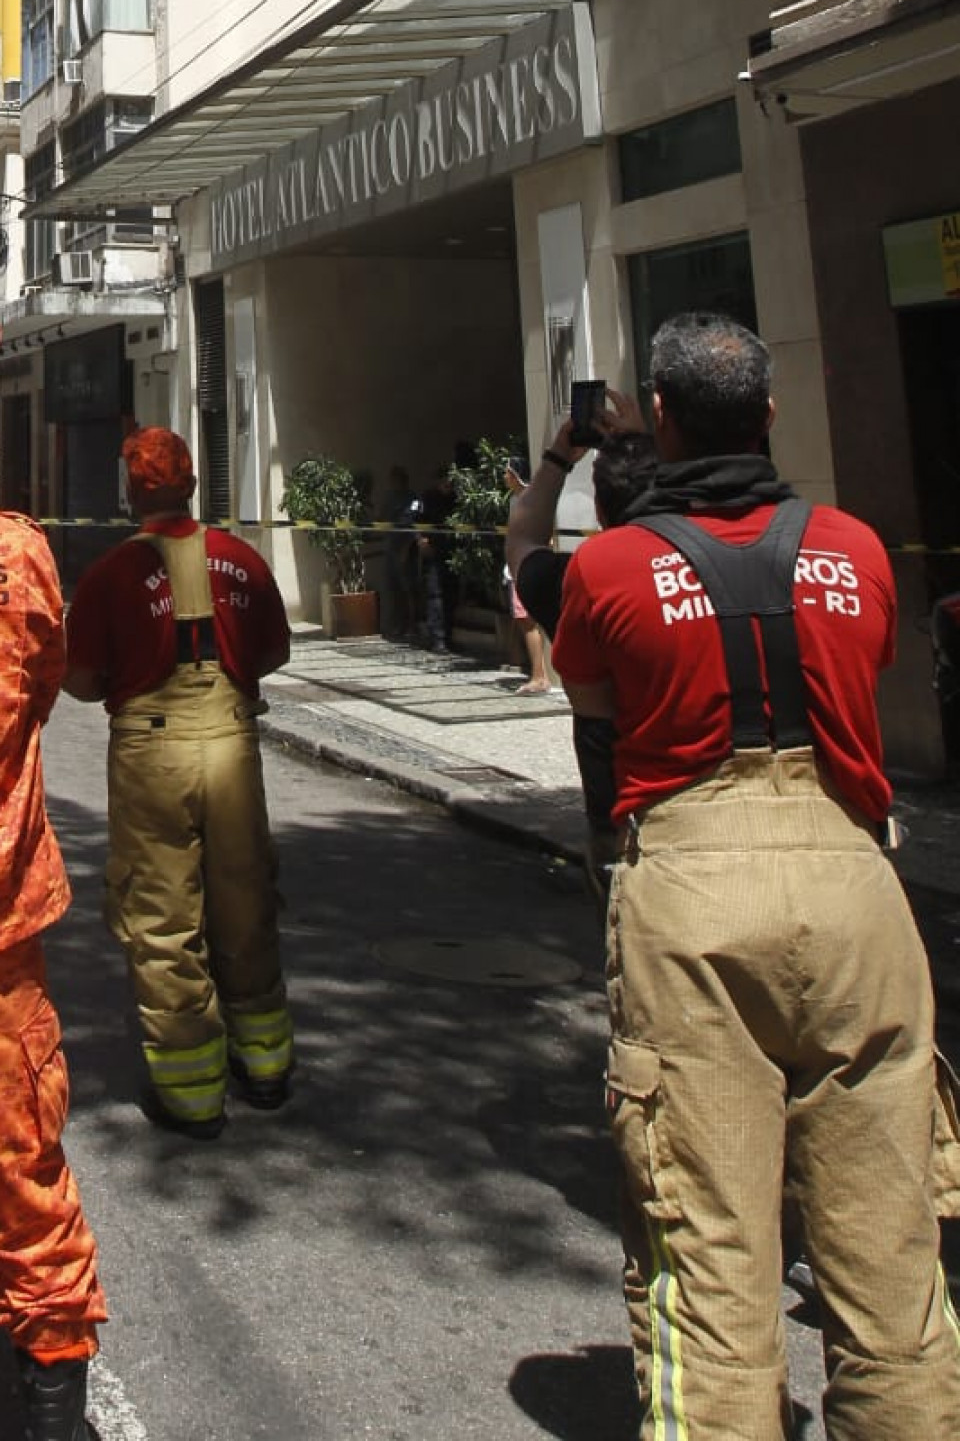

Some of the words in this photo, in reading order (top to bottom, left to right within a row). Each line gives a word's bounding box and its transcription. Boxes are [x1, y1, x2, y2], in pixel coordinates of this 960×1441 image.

[210, 175, 272, 254] HOTEL
[276, 112, 411, 232] ATLANTICO
[416, 35, 580, 180] BUSINESS
[825, 590, 861, 617] RJ
